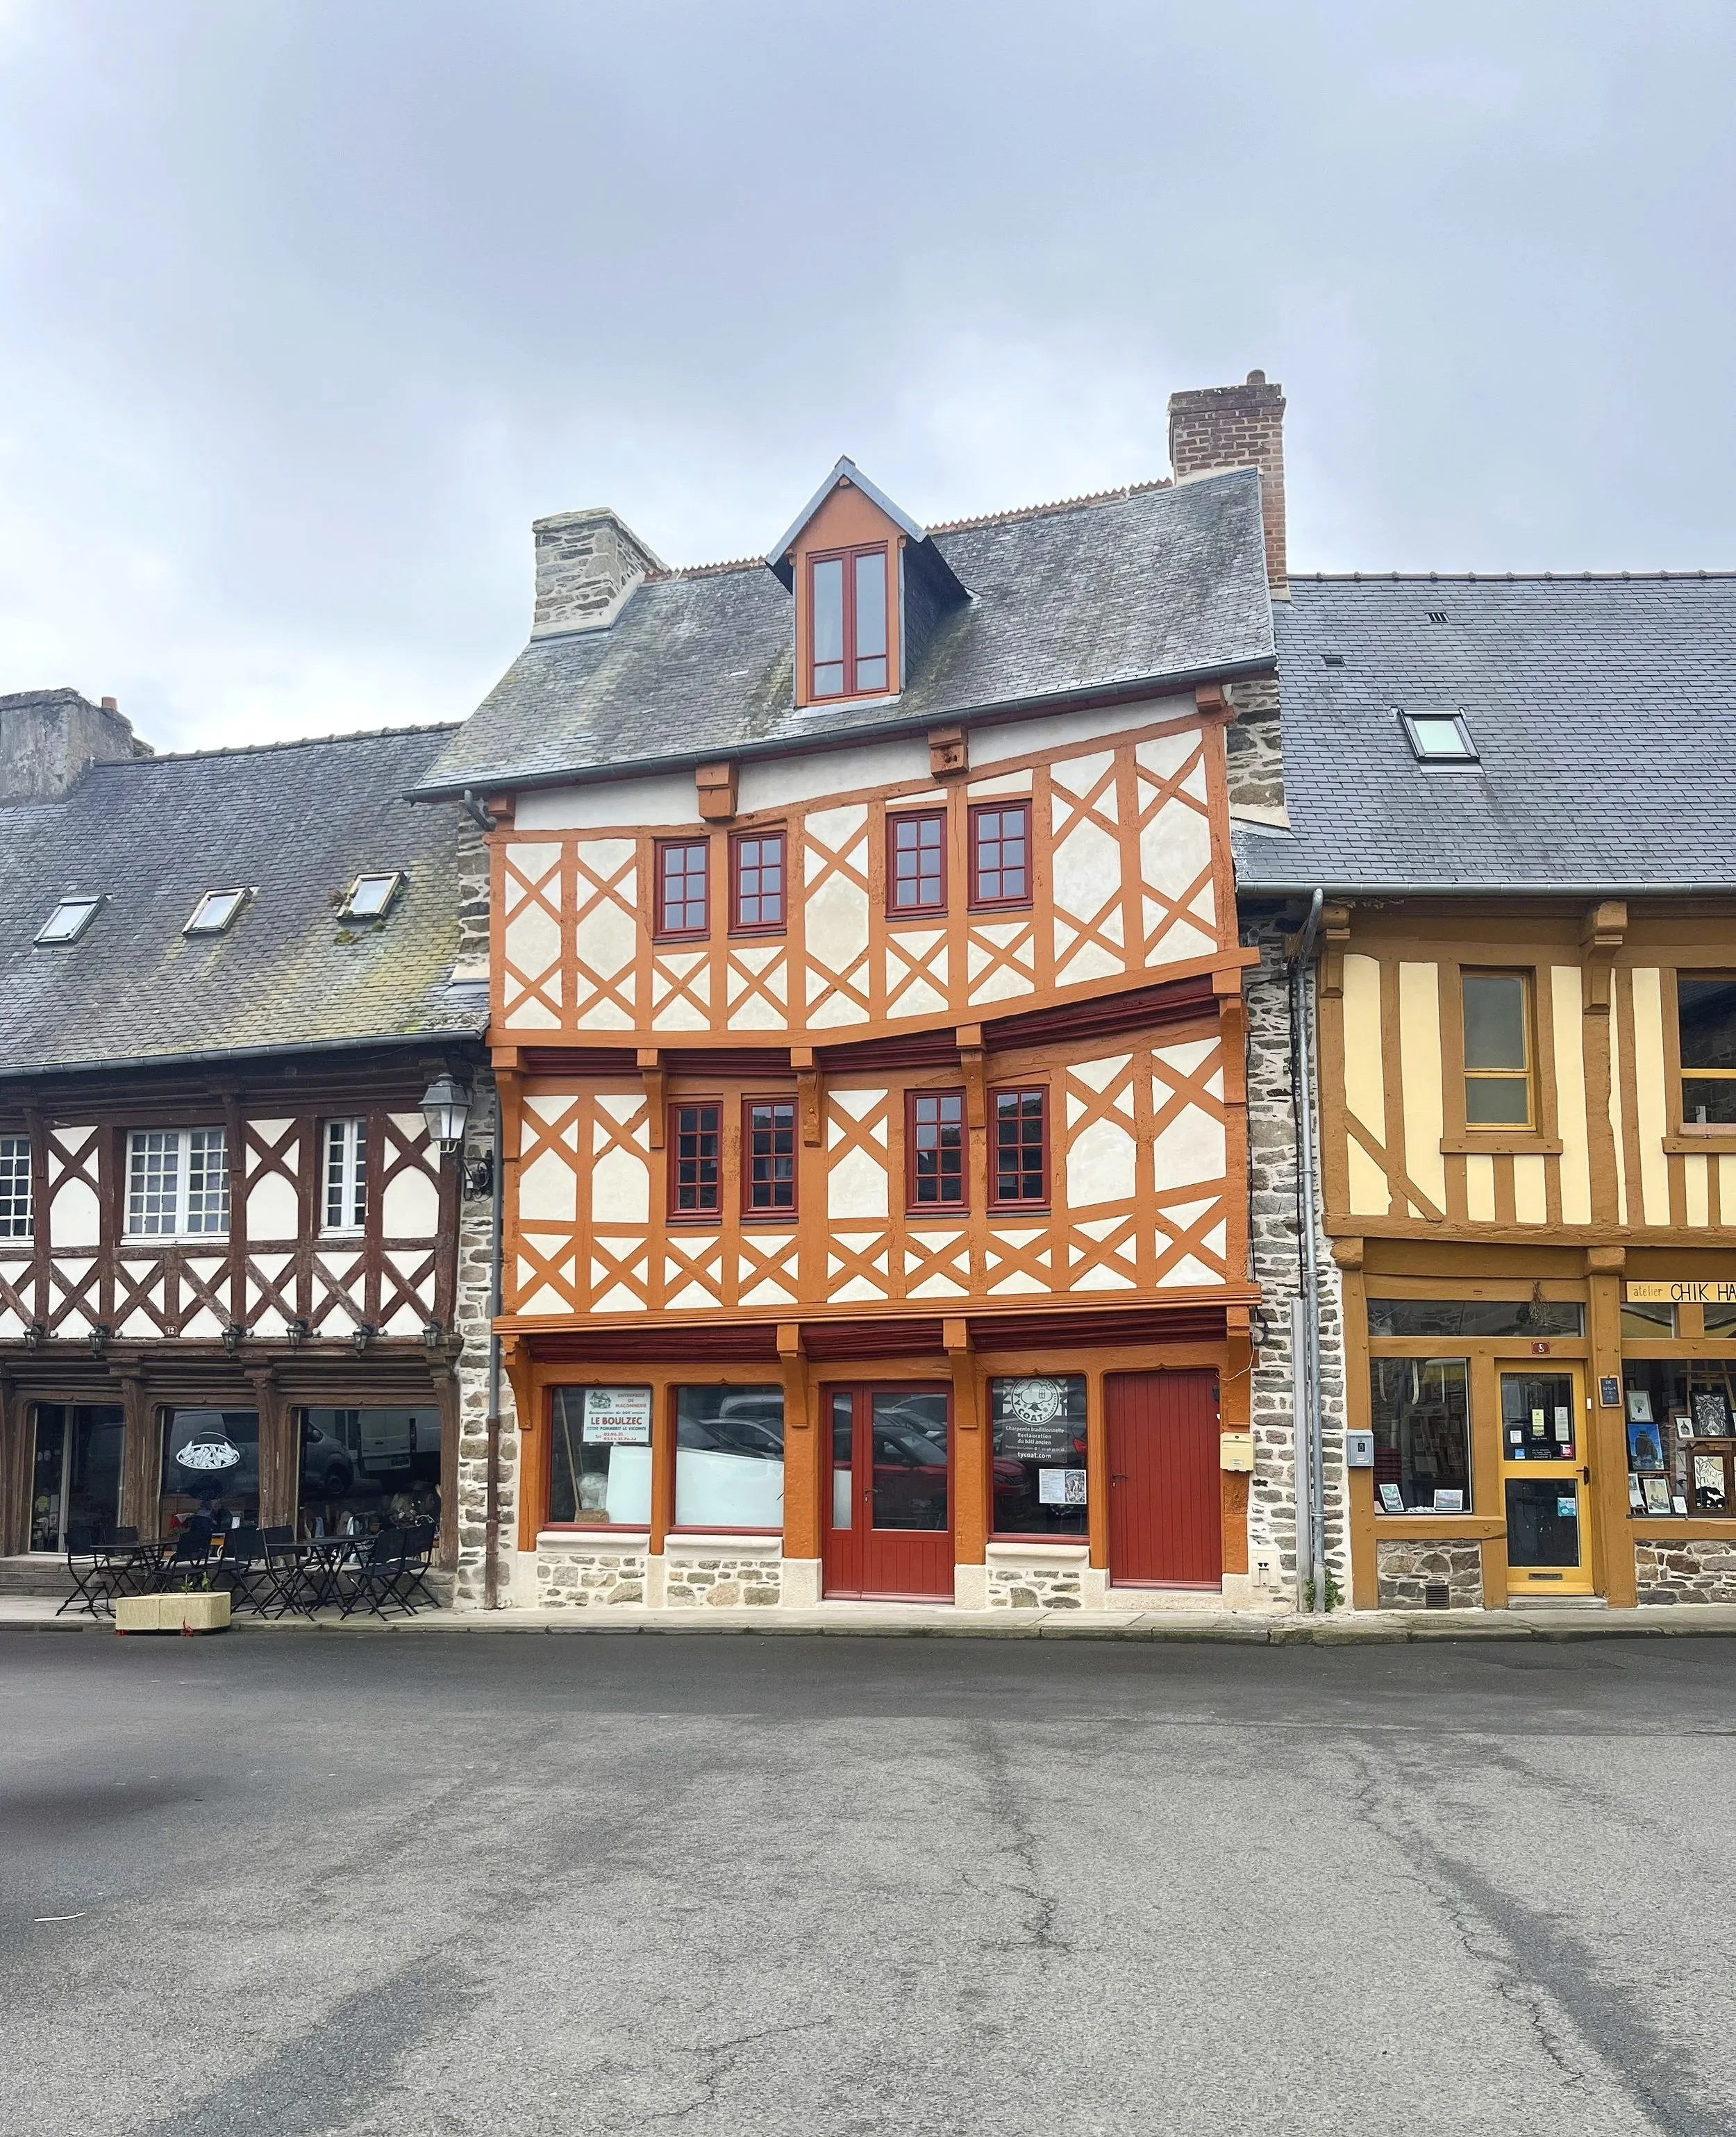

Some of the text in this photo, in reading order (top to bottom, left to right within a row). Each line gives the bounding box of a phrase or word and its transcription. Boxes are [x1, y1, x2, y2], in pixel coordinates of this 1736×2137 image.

[1633, 1285, 1663, 1297] atelier
[1671, 1283, 1710, 1301] CHIK
[1015, 1393, 1021, 1406] TY
[1018, 1408, 1043, 1421] COAT
